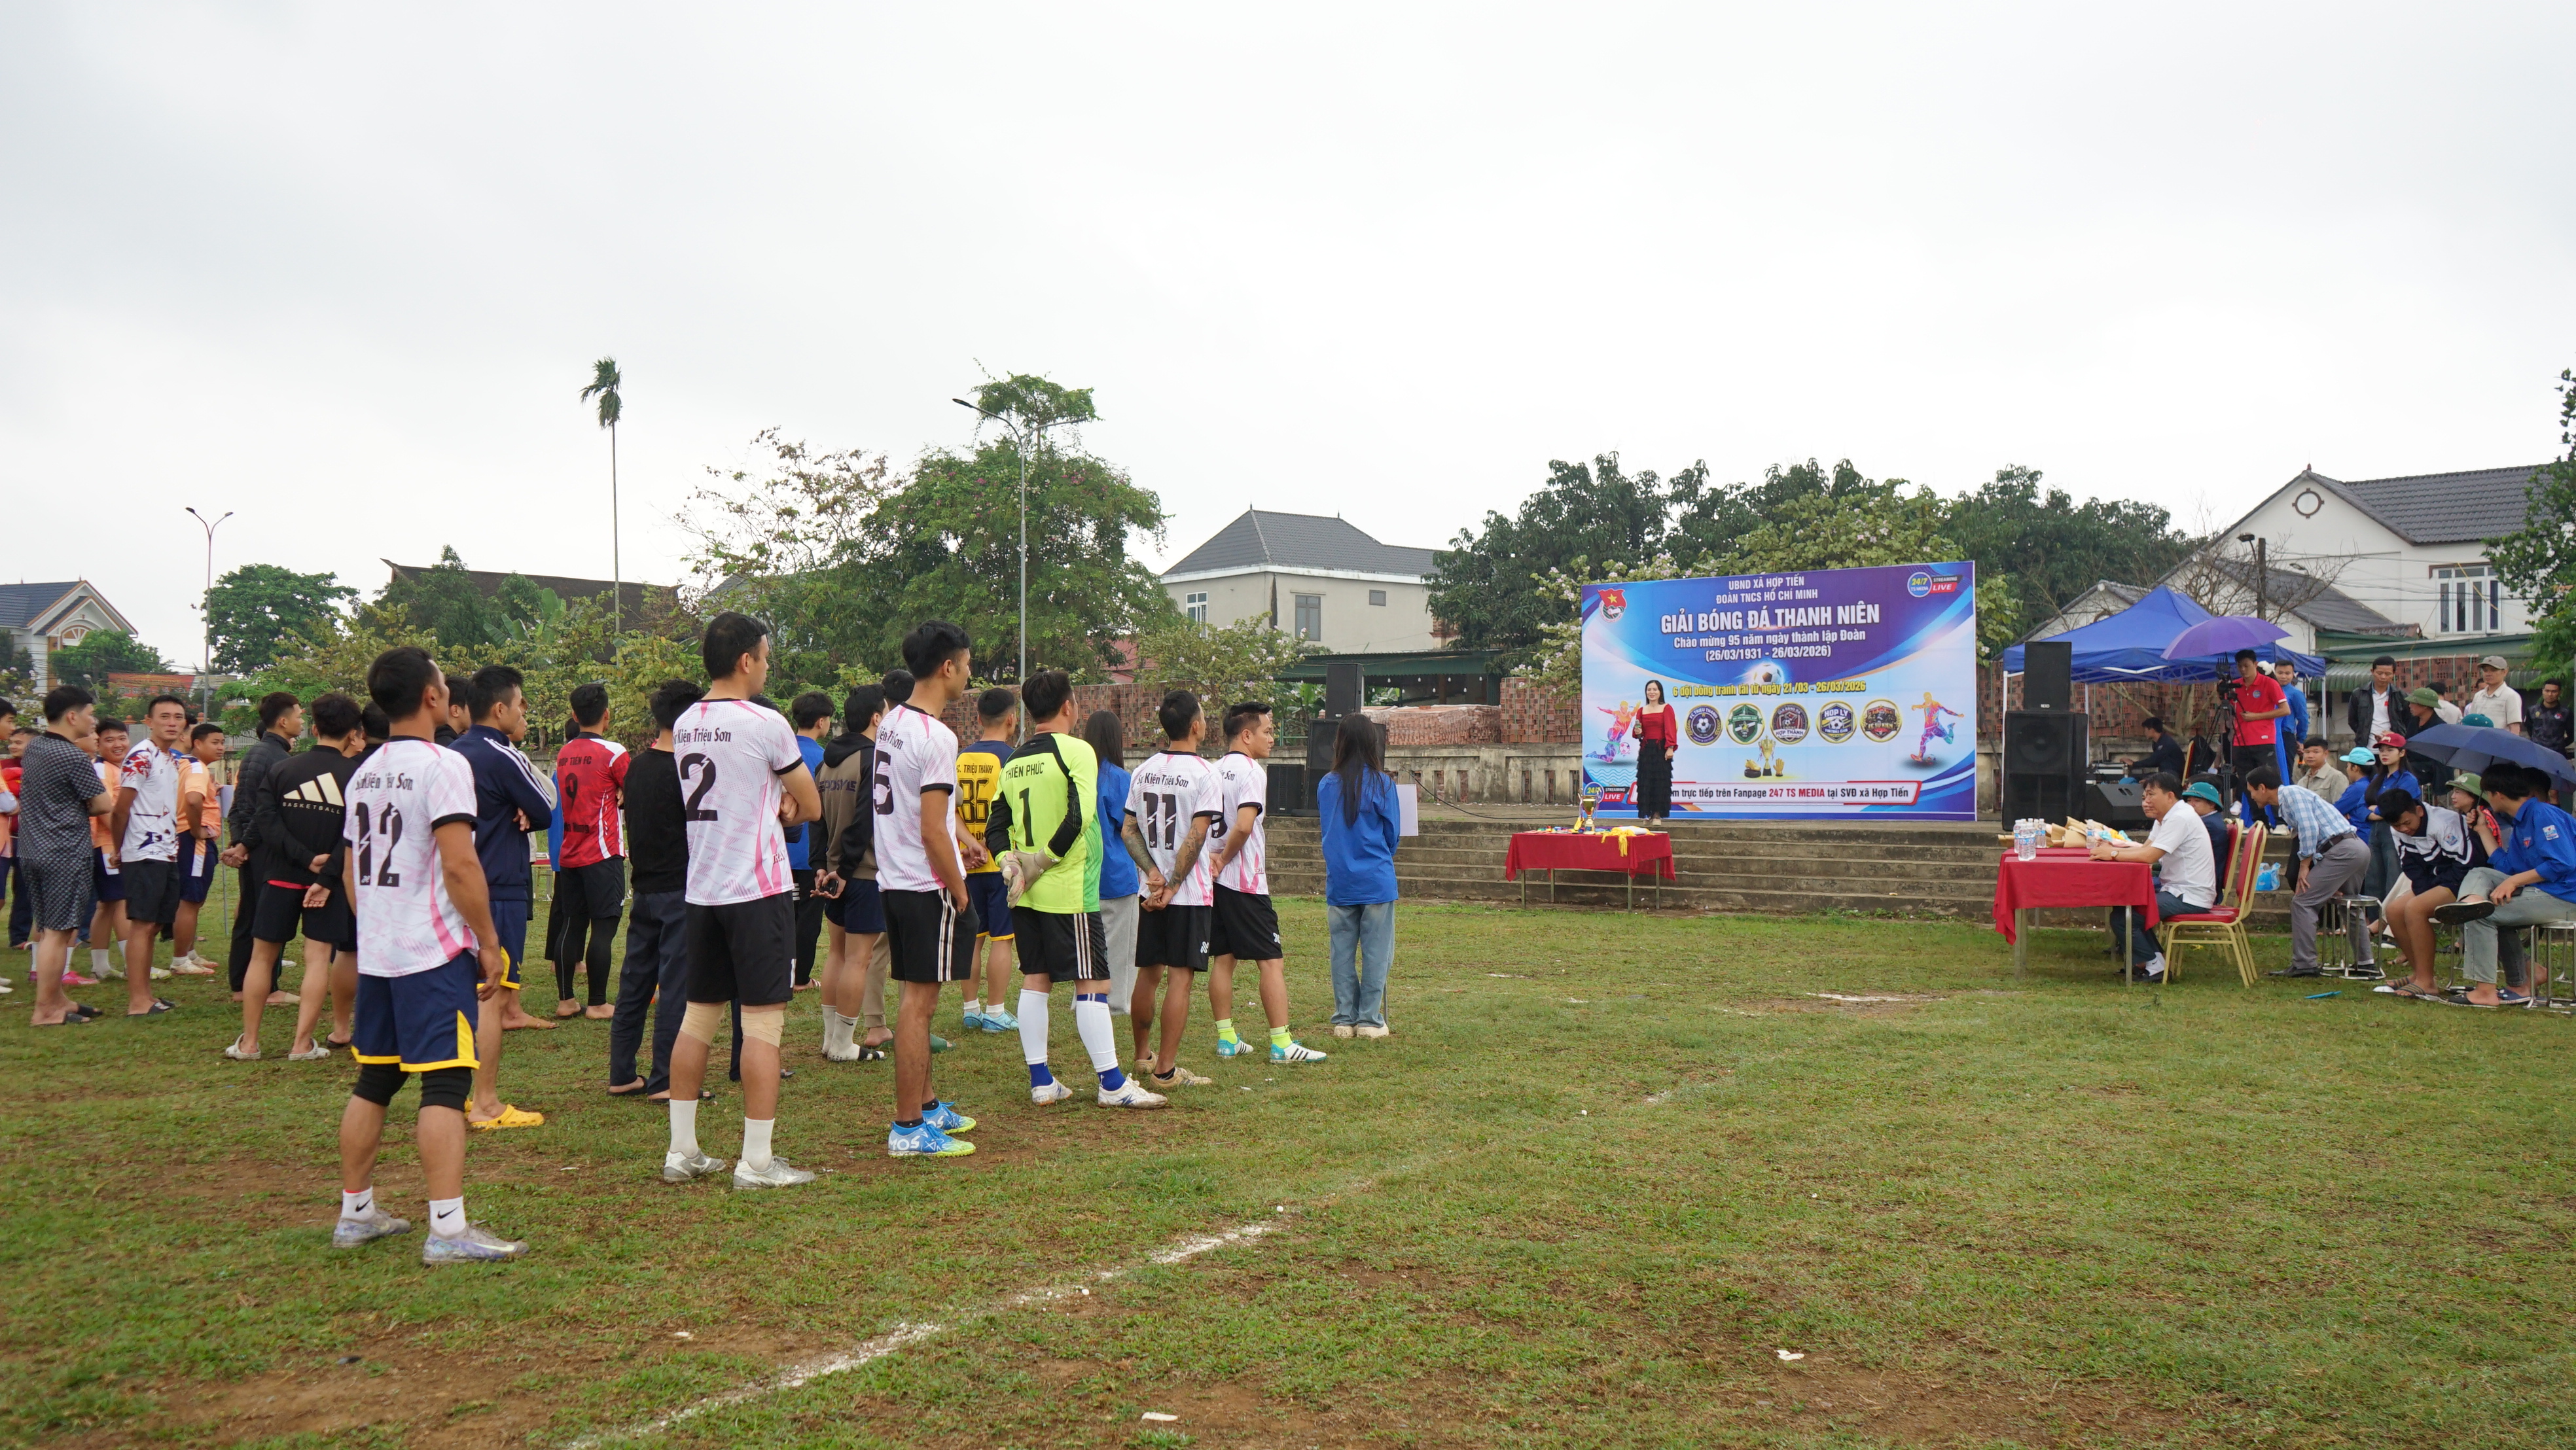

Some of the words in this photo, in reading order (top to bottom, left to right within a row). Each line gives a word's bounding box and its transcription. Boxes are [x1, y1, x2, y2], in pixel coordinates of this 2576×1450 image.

[1728, 580, 1751, 590] UBND
[1753, 578, 1764, 589] XÃ
[1766, 577, 1783, 589] HỢP
[1785, 574, 1804, 587] TIẾN
[1911, 577, 1928, 586] 24/7
[1716, 592, 1738, 604] ĐOÀN
[1741, 592, 1762, 603] TNCS
[1764, 588, 1776, 601] HỒ
[1778, 588, 1793, 601] CHÍ
[1795, 589, 1818, 599] MINH
[1661, 608, 1693, 633] GIẢI
[1698, 608, 1744, 631] BÓNG
[1747, 605, 1768, 629] ĐÁ
[1774, 606, 1832, 628] THANH
[1837, 600, 1880, 625] NIÊN
[1673, 636, 1697, 648] Chào
[1700, 634, 1726, 648] mừng
[1728, 635, 1740, 646] 95
[1742, 633, 1763, 645] năm
[1766, 632, 1789, 646] ngày
[1791, 631, 1819, 643] thành
[1822, 629, 1838, 644] lập
[1840, 628, 1866, 641] Đoàn
[1706, 647, 1762, 662] (26/03/1931
[1772, 645, 1831, 659] 26/03/2026)
[1673, 687, 1678, 697] 6
[1680, 686, 1692, 698] đội
[1694, 684, 1713, 697] bóng
[1715, 685, 1736, 696] tranh
[1738, 683, 1748, 695] tài
[1750, 682, 1761, 694] từ
[1761, 683, 1781, 696] ngày
[1783, 683, 1792, 694] 21
[1816, 681, 1867, 692] 26/03/2026
[677, 729, 691, 746] Kiện
[694, 728, 712, 745] Triệu
[714, 728, 731, 742] Sơn
[583, 756, 592, 765] FC
[963, 763, 978, 775] TRIỆU
[978, 762, 993, 774] THÀNH
[1005, 765, 1024, 782] THIÊN
[1026, 760, 1045, 777] PHÚC
[1145, 772, 1160, 787] Kiện
[1175, 775, 1189, 788] Sơn
[397, 772, 414, 791] Sơn
[679, 752, 718, 822] 2
[874, 749, 894, 815] 5
[565, 773, 578, 809] 9
[1682, 788, 1696, 799] trực
[1699, 787, 1713, 799] tiếp
[1716, 788, 1731, 798] trên
[1734, 788, 1766, 799] Fanpage
[1769, 788, 1784, 798] 247
[1786, 788, 1796, 798] TS
[1798, 788, 1825, 798] MEDIA
[1827, 788, 1838, 799] tại
[1840, 788, 1857, 798] SVĐ
[1859, 788, 1869, 797] xã
[1872, 788, 1887, 799] Hợp
[1891, 785, 1908, 798] Tiến
[282, 802, 340, 814] BASKETBALL
[1019, 787, 1035, 847] 1
[1143, 792, 1176, 850] 11
[355, 802, 402, 887] 12
